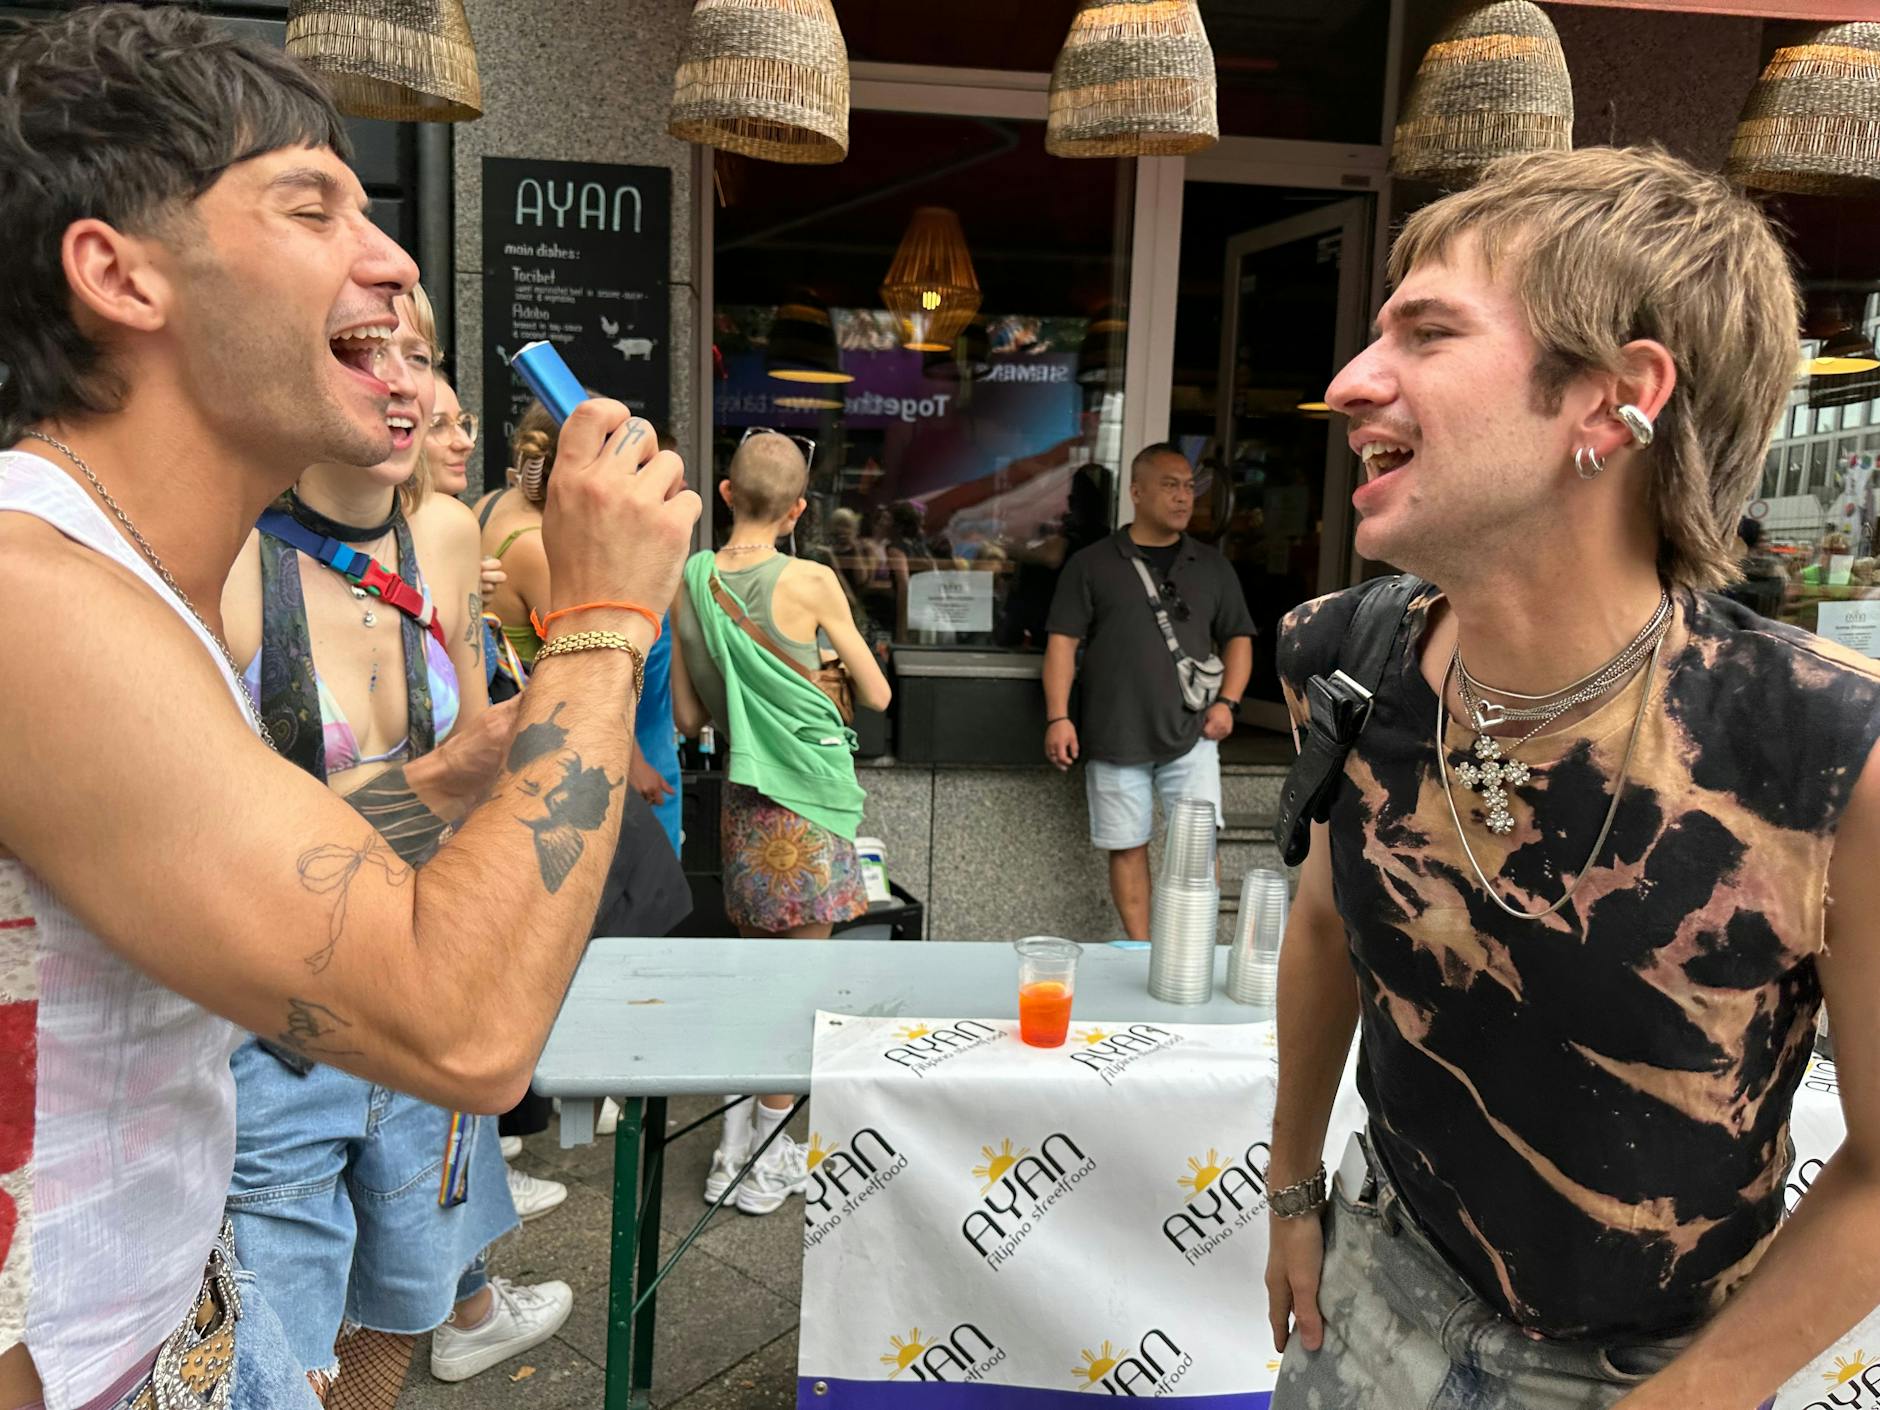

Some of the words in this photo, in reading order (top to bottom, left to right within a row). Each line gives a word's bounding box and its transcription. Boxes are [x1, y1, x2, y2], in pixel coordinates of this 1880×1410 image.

[516, 178, 641, 233] AYAN
[504, 243, 534, 256] main
[536, 242, 580, 259] dishes:
[512, 303, 550, 320] Adobo
[884, 1020, 995, 1067] AYAN
[1070, 1024, 1170, 1071] AYAN
[803, 1215, 841, 1250] ilipino
[842, 1153, 908, 1216] streetfood
[805, 1128, 896, 1227] YAN
[962, 1132, 1085, 1258] AYAN
[987, 1222, 1031, 1272] filipino
[1032, 1157, 1096, 1221] streetfood
[1185, 1227, 1233, 1266] filipino
[1235, 1193, 1270, 1229] stree
